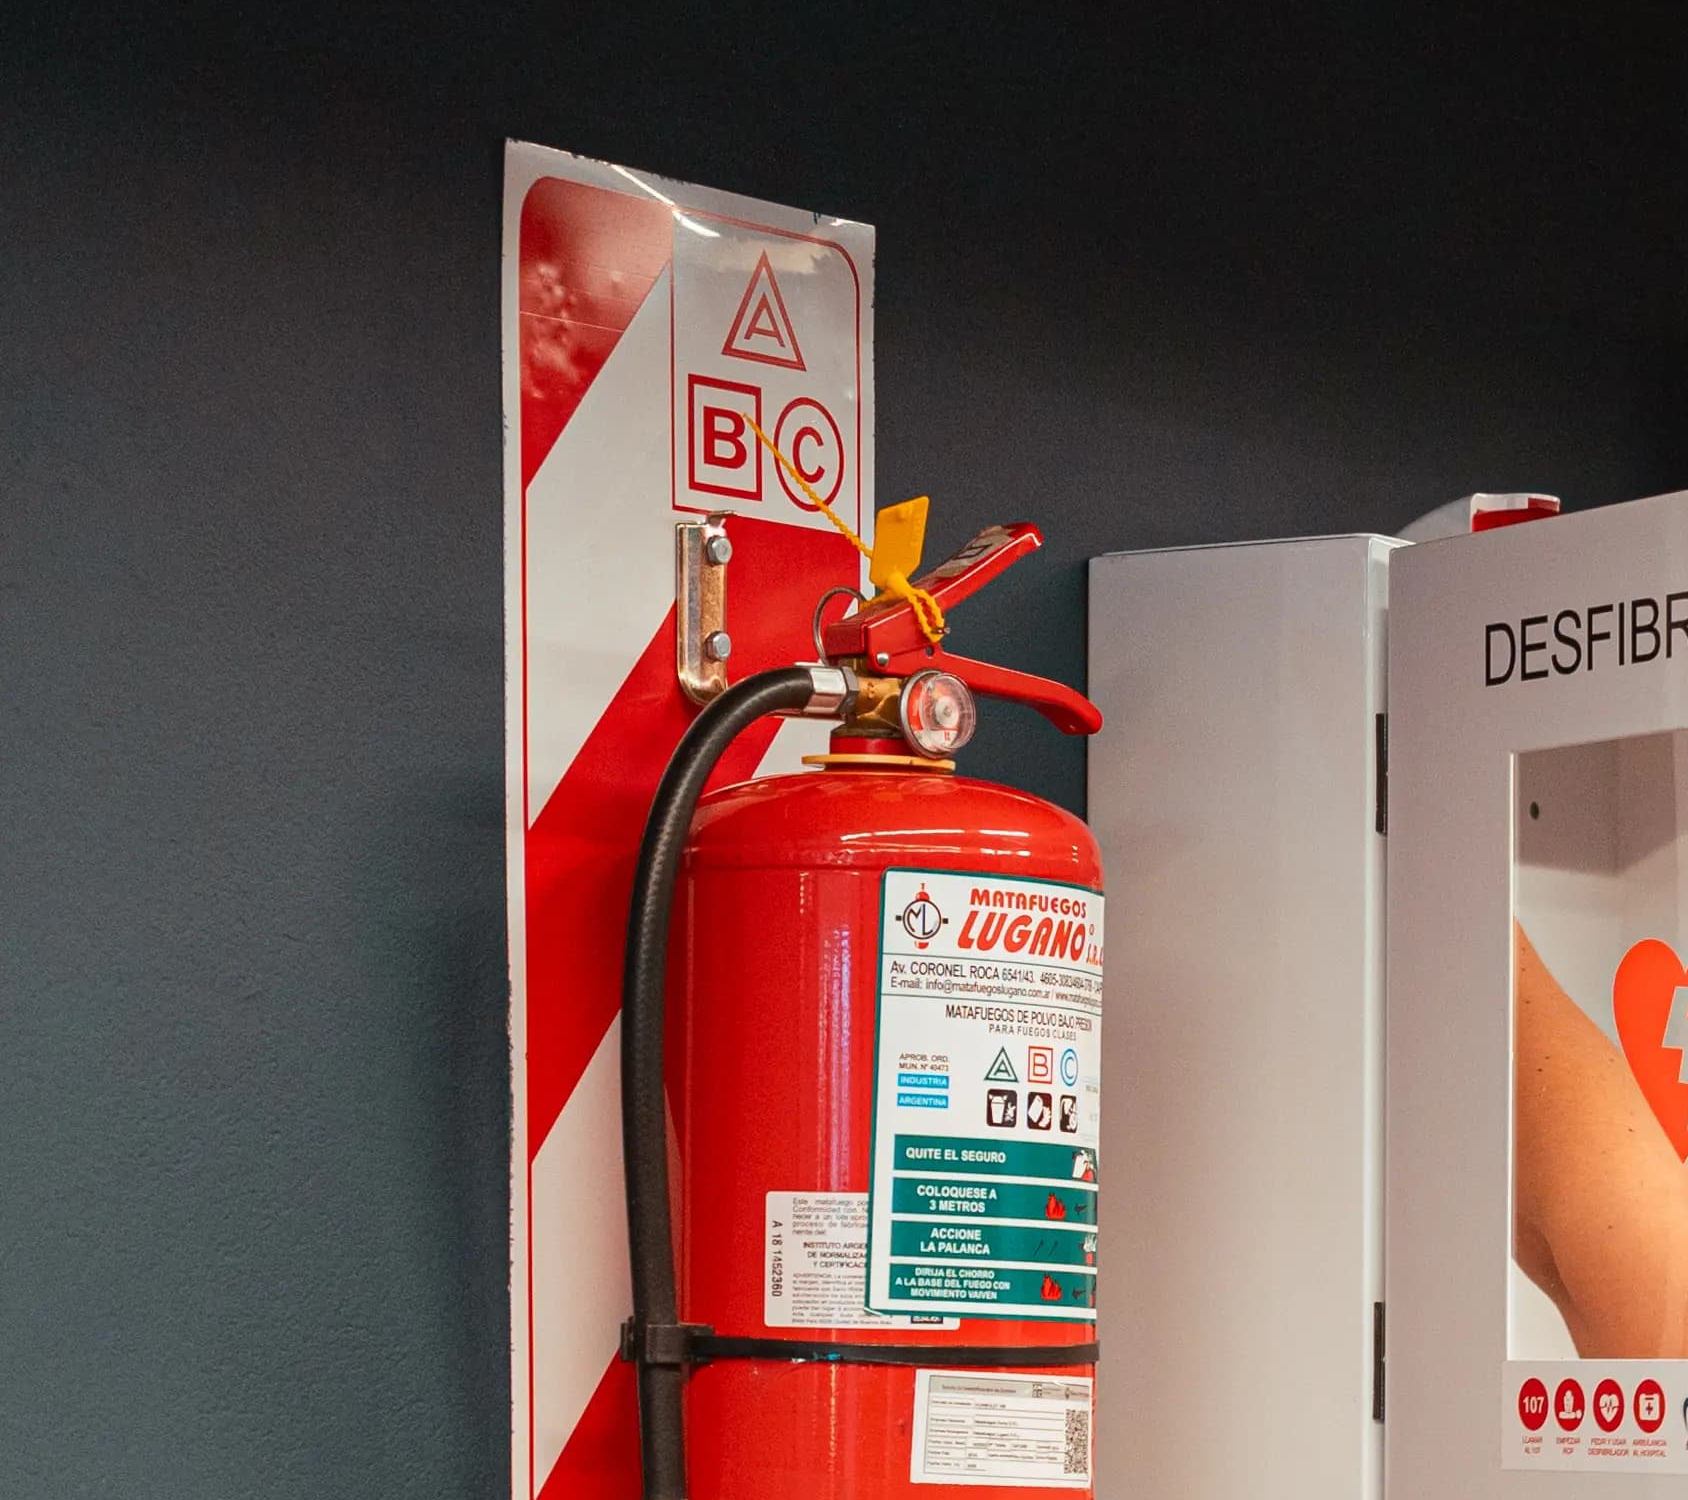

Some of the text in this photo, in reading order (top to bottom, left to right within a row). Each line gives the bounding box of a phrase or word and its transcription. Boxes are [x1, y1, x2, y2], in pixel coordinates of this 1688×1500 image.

[743, 292, 785, 348] A
[702, 405, 827, 484] B C
[970, 888, 1087, 919] MATAFUEGOS
[957, 910, 1086, 961] LUGANO
[890, 961, 906, 974] Av.
[911, 962, 966, 978] CORONEL
[970, 965, 999, 980] ROCA
[890, 976, 923, 989] E-mail:
[945, 1004, 1015, 1023] MATAFUEGOS
[1017, 1010, 1029, 1024] DE
[1031, 1011, 1057, 1027] POLVO
[989, 1023, 1014, 1034] PARA
[1017, 1025, 1050, 1038] FUEGOS
[993, 1053, 1075, 1080] A B C
[900, 1076, 948, 1086] INDUSTRIA
[899, 1096, 947, 1107] ARGENTINA
[906, 1147, 1006, 1163] QUITE EL SEGURO
[917, 1185, 997, 1200] COLOQUESE A
[929, 1200, 985, 1213] 3 METROS
[771, 1234, 783, 1246] 18
[930, 1228, 982, 1241] ACCIONE
[920, 1241, 990, 1255] LA PALANCA
[915, 1267, 995, 1279] DIRIJA EL CHORRO
[895, 1277, 1011, 1290] A LA BASE DEL FUEGO CON
[910, 1288, 997, 1300] MOVIMIENTO VAIVEN
[1523, 1396, 1544, 1414] 107
